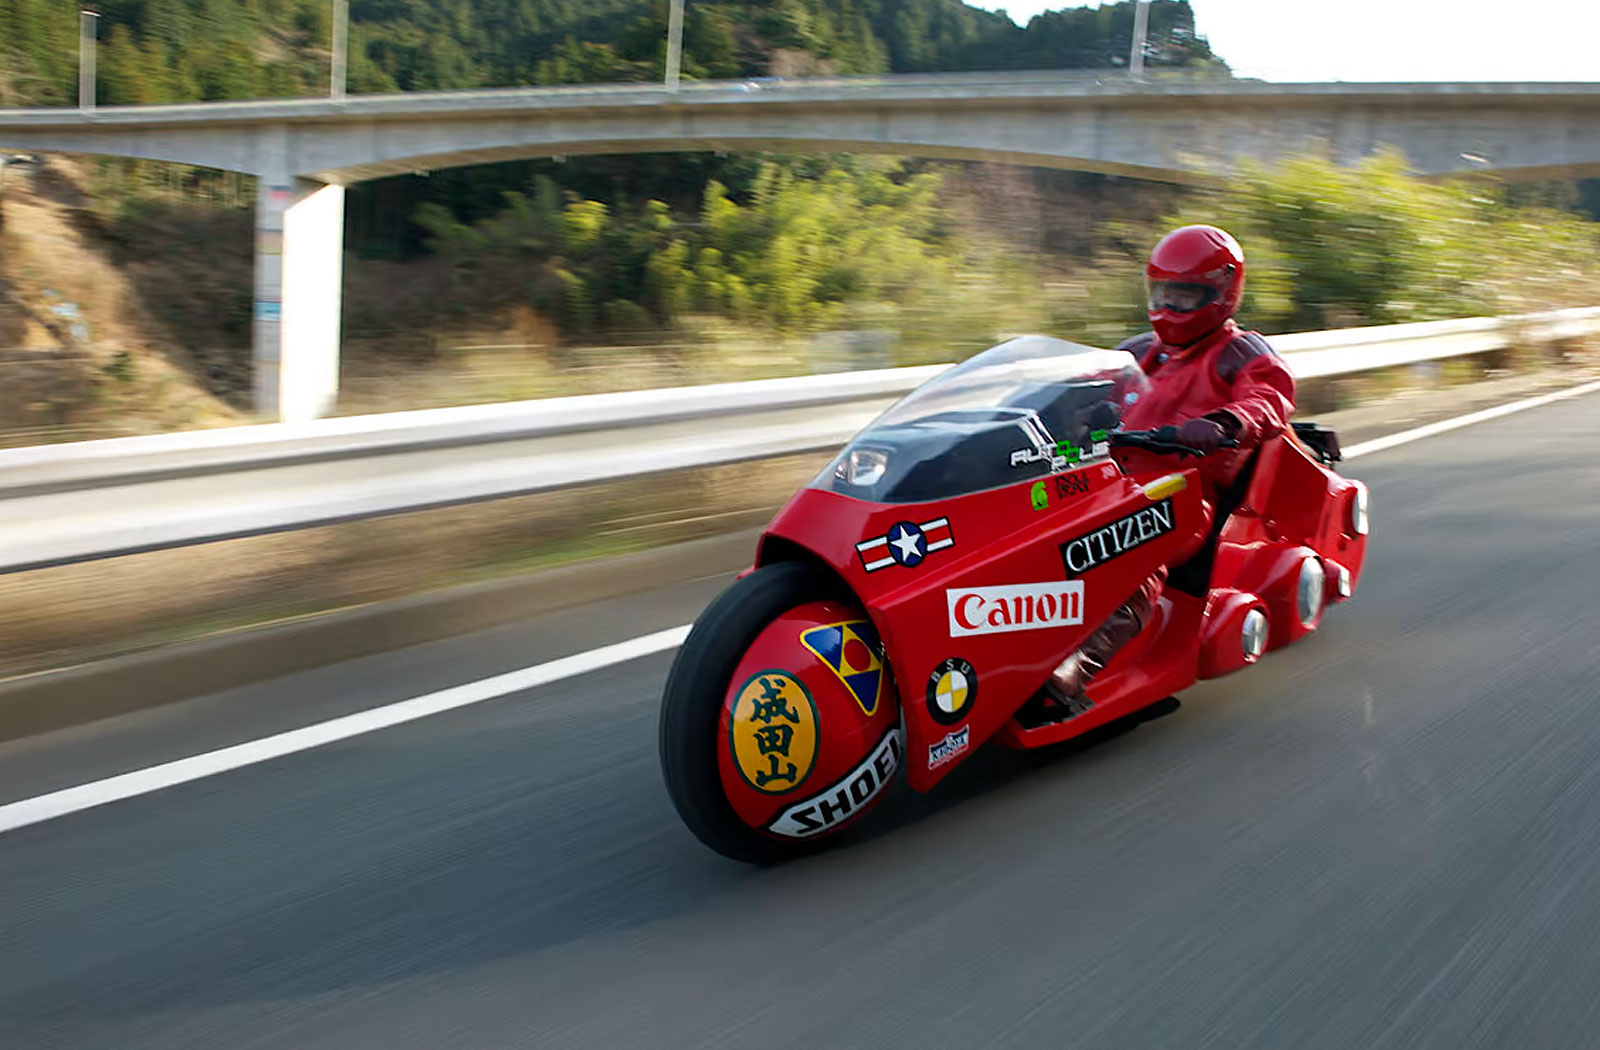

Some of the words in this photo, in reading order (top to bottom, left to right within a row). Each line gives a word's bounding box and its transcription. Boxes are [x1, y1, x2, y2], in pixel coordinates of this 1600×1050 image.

[1066, 502, 1172, 572] CITIZEN
[953, 591, 1080, 630] Canon
[750, 677, 800, 786] 成田山
[790, 736, 899, 835] SHOEI
